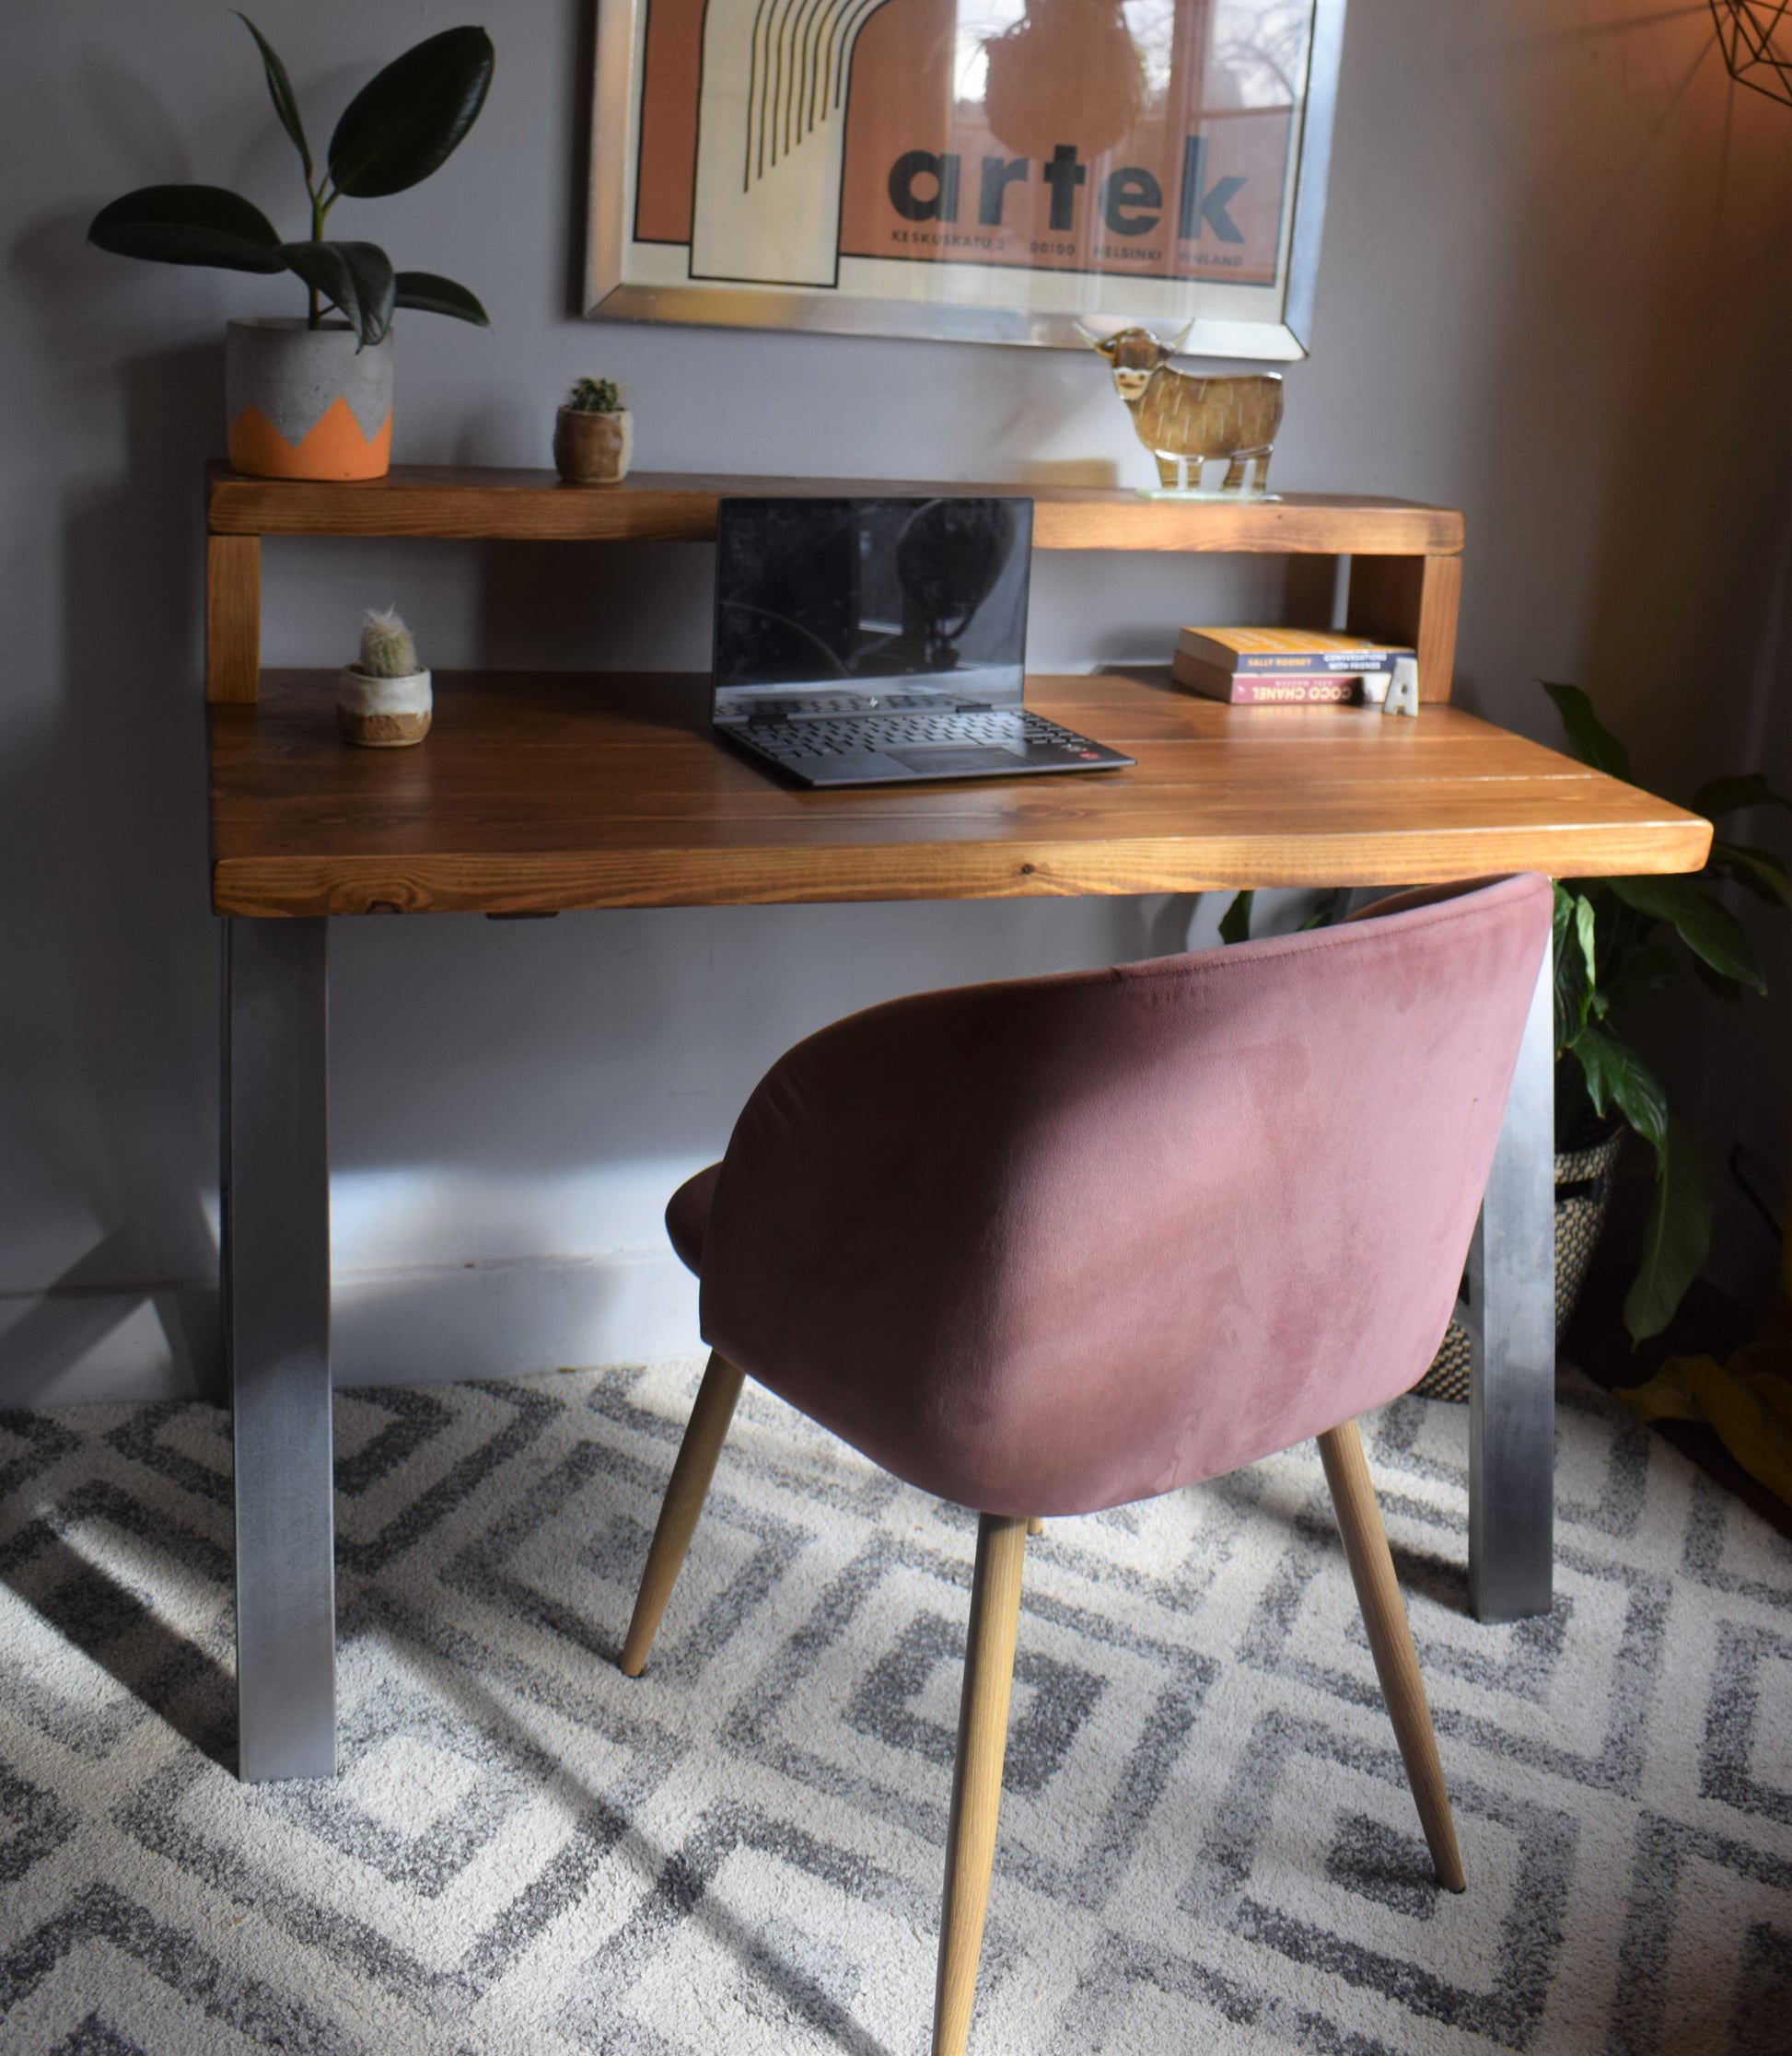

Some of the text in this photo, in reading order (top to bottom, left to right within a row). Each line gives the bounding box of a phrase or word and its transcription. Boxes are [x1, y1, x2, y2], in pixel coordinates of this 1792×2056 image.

[888, 134, 1248, 245] artek
[1093, 246, 1162, 261] HELSINKI
[1247, 657, 1312, 668] SALLY ROONEY
[1251, 687, 1353, 701] COCO CHANEL
